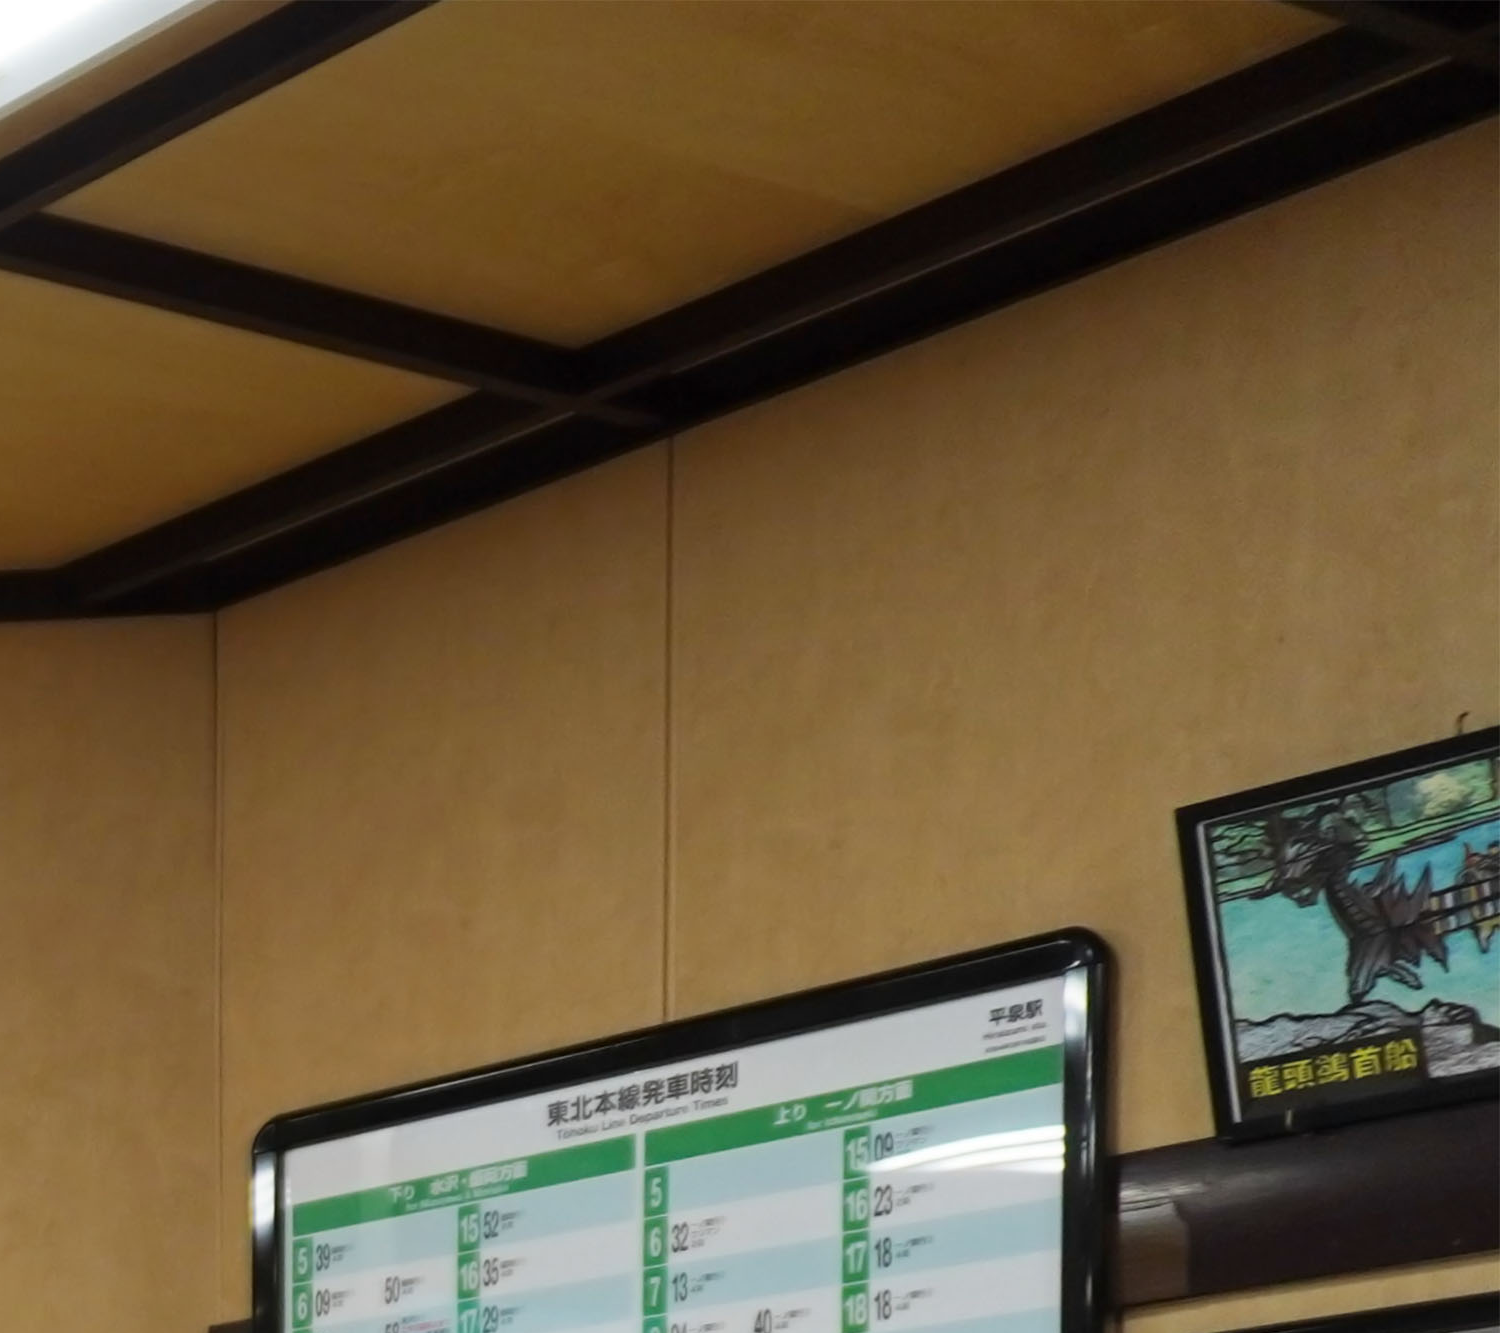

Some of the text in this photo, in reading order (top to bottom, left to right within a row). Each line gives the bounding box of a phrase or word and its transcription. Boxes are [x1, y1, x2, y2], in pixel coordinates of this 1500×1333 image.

[988, 1000, 1044, 1024] 平泉駅
[547, 1062, 739, 1128] 東北本線発車時刻
[772, 1105, 806, 1125] 上り
[482, 1211, 499, 1239] 52
[671, 1223, 690, 1253] 32
[316, 1244, 331, 1271] 39
[874, 1237, 892, 1268] 18
[671, 1272, 688, 1302] 13
[482, 1306, 499, 1333] 29
